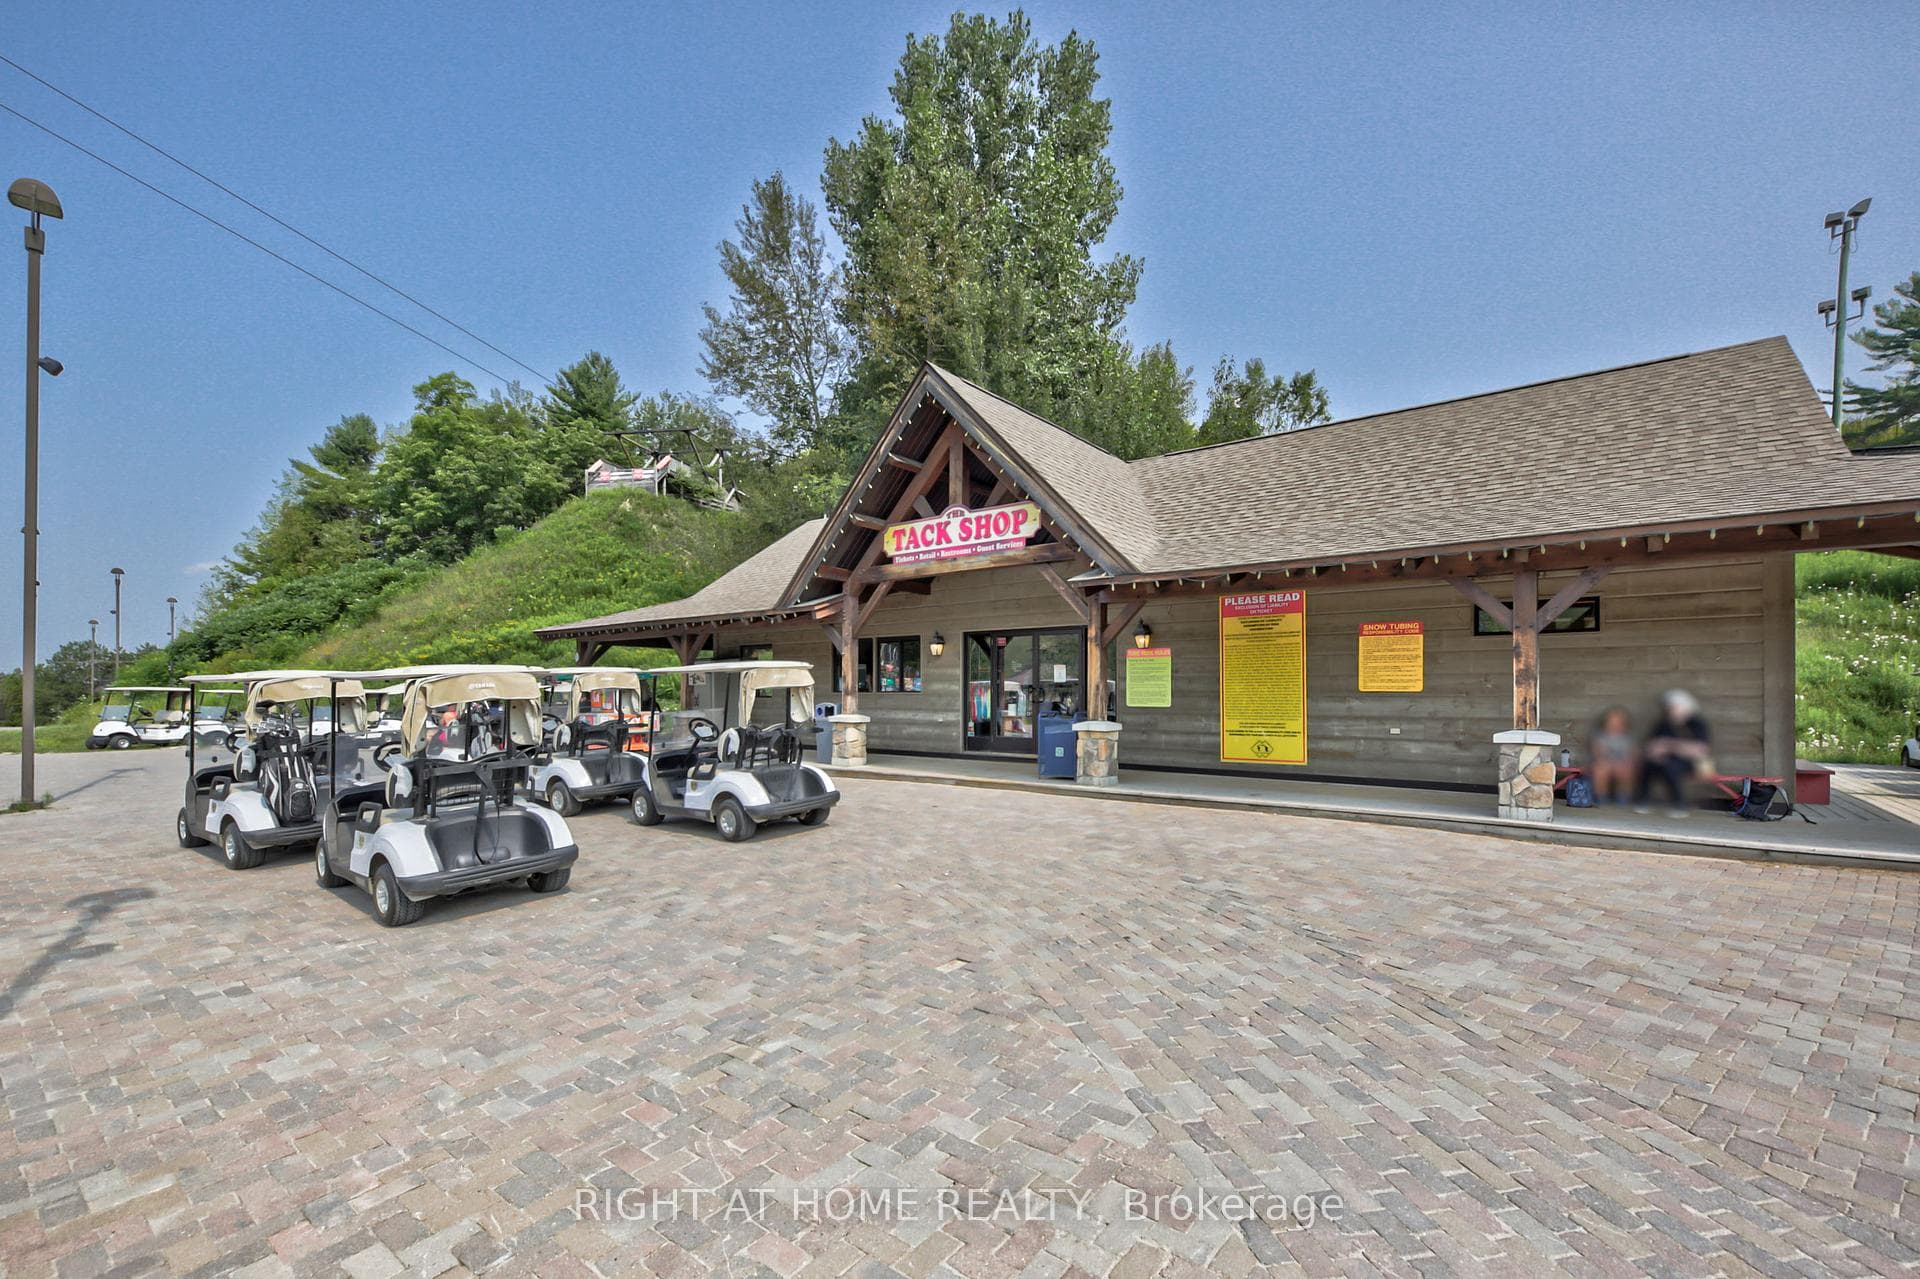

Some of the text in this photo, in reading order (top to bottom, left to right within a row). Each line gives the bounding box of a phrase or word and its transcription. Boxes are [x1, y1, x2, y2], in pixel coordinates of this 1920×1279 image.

[893, 509, 1028, 551] TACK SHOP
[919, 551, 936, 560] Retail
[976, 543, 995, 552] Guest
[1224, 592, 1300, 606] PLEASE READ
